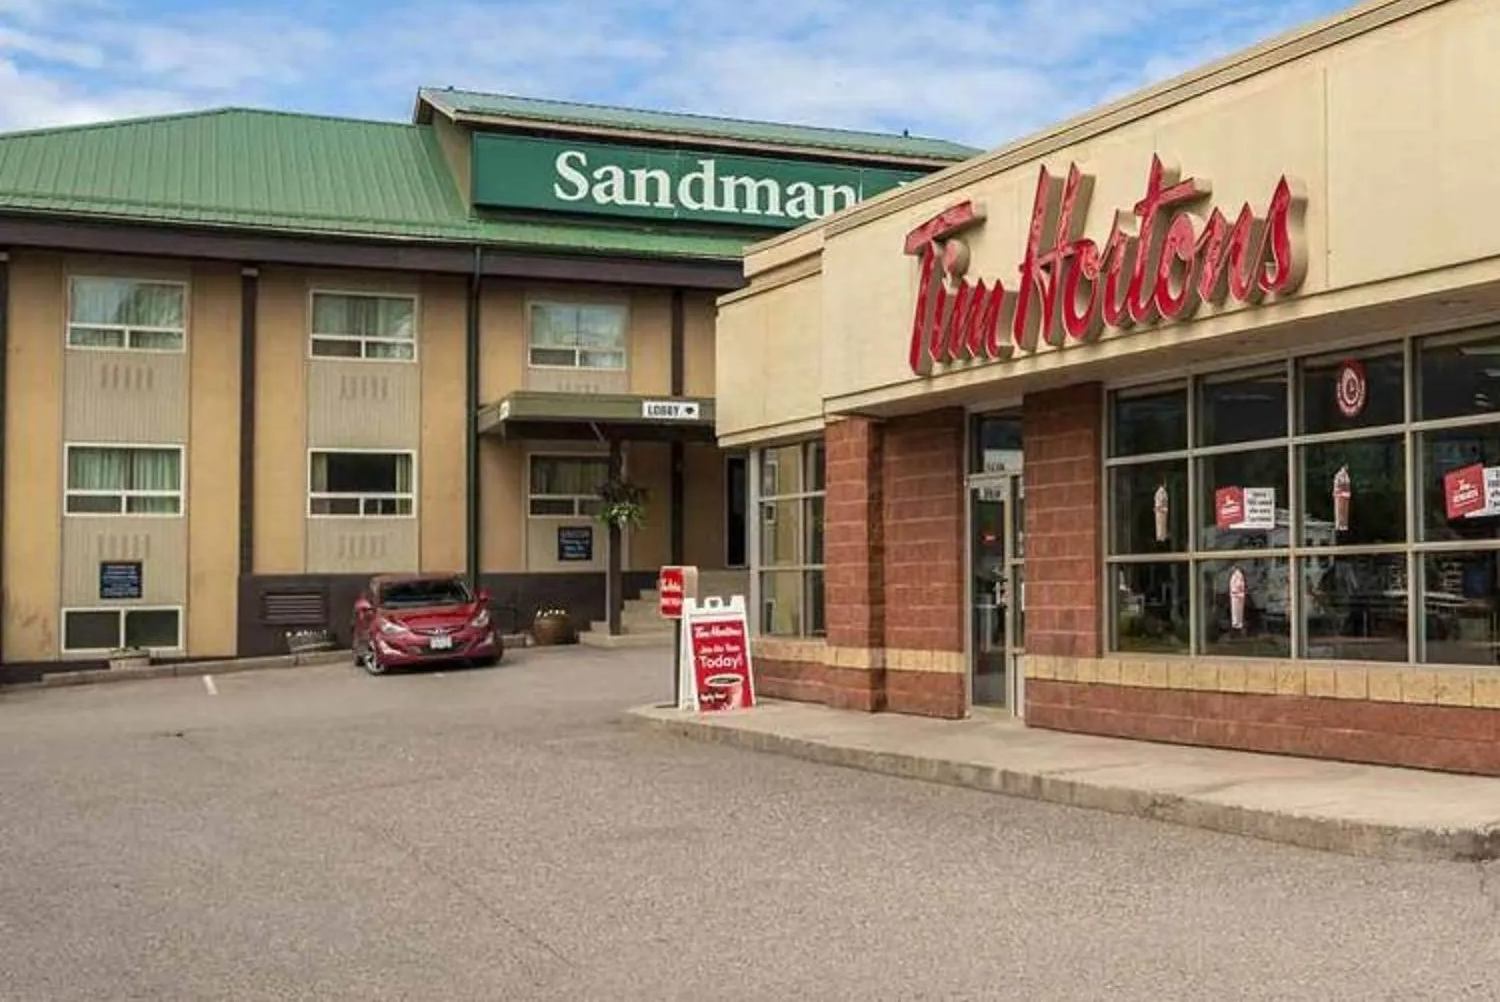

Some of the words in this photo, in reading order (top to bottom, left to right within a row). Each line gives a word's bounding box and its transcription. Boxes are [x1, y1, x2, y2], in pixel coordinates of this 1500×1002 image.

[553, 150, 857, 219] Sandman
[903, 199, 1010, 377] Tim
[1014, 152, 1304, 352] Hortons
[699, 653, 743, 670] Today!
